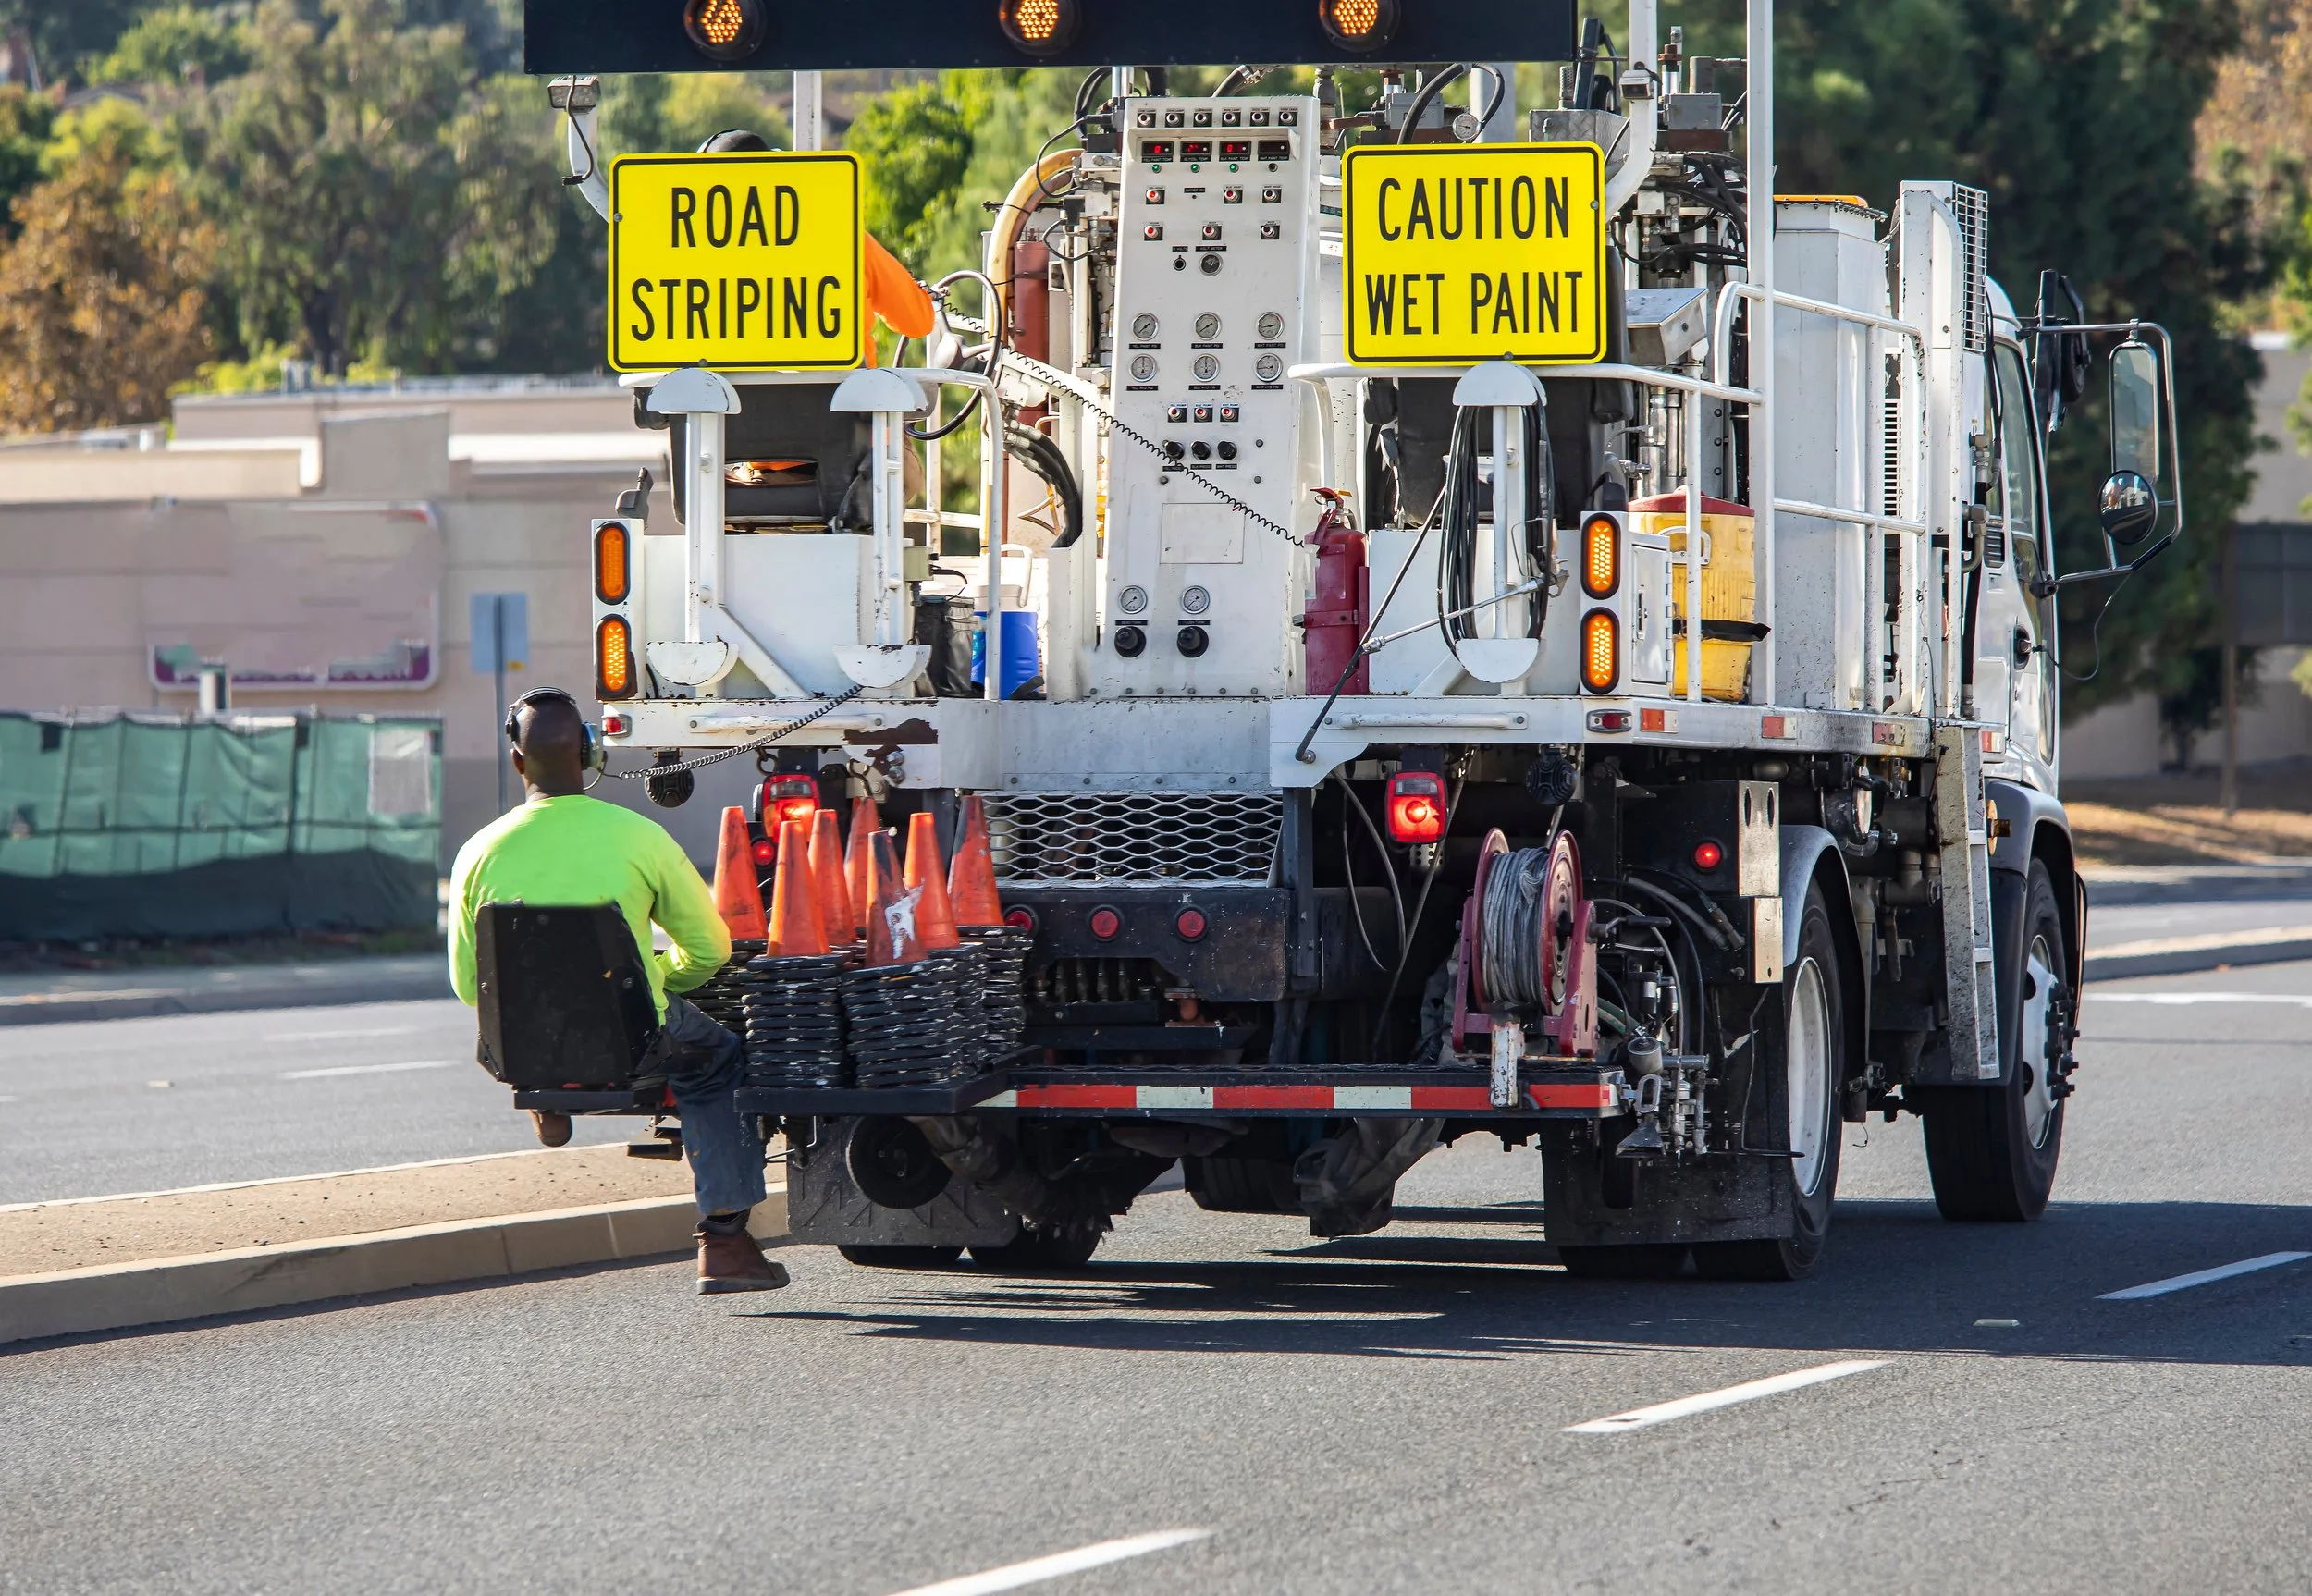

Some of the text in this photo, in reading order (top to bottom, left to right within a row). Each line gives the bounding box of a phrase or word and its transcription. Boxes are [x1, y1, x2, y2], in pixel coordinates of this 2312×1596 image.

[670, 184, 799, 248] ROAD
[1378, 175, 1568, 241] CAUTION
[631, 276, 841, 341] STRIPING
[1365, 271, 1583, 335] WET PAINT
